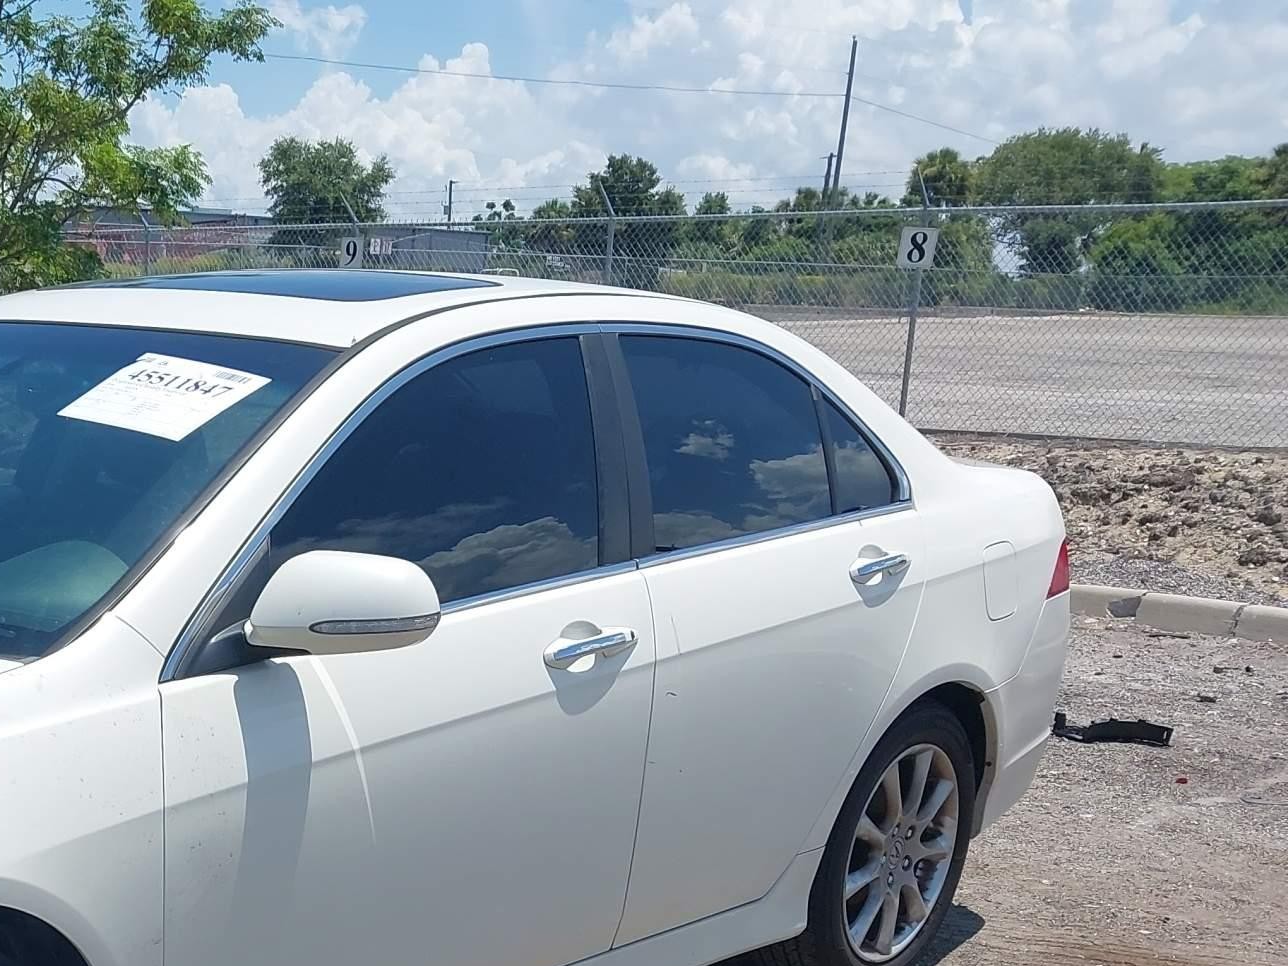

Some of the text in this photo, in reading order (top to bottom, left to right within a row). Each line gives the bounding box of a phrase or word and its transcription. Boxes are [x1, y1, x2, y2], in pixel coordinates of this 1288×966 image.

[344, 240, 358, 266] 9
[907, 231, 928, 263] 8
[128, 369, 233, 397] 45511847
